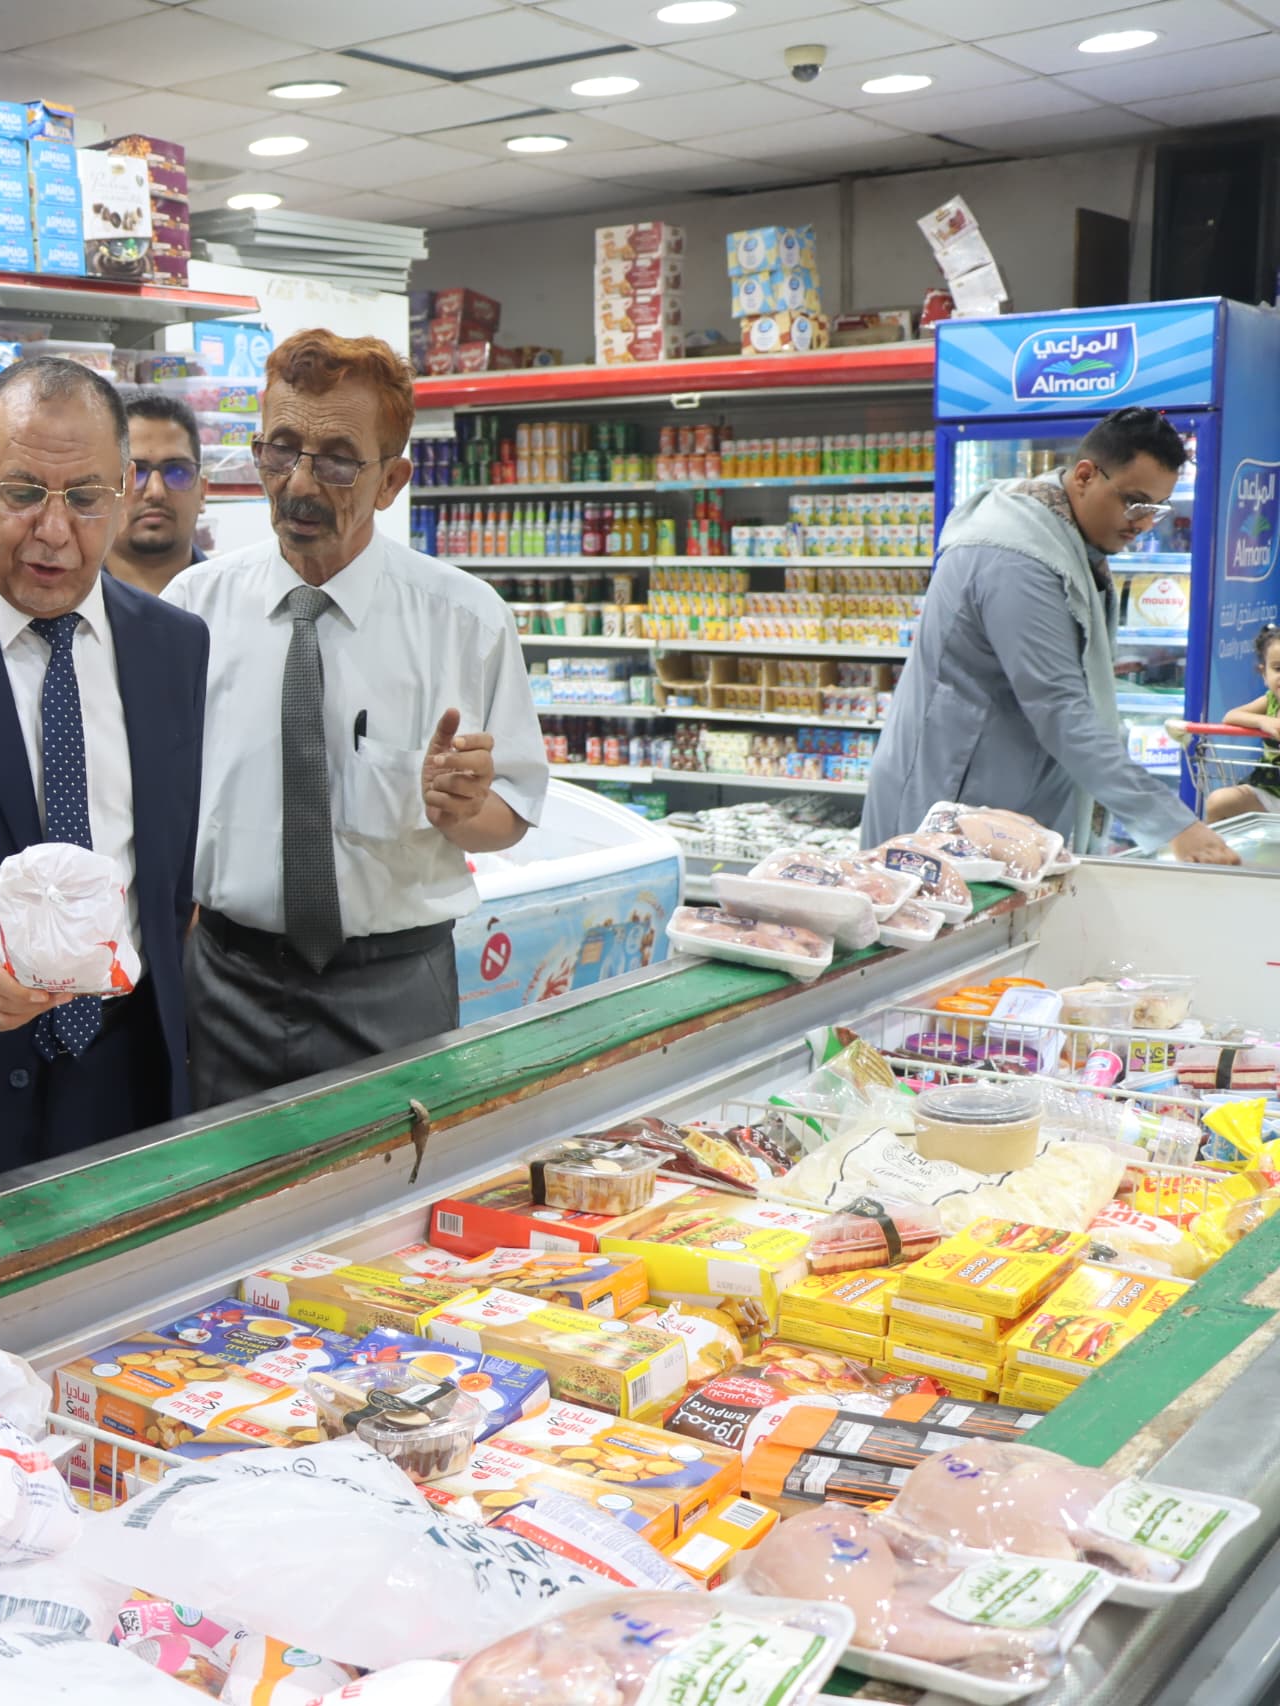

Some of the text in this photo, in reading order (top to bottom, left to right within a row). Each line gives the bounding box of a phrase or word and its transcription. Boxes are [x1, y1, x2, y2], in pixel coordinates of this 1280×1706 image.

[1032, 332, 1118, 359] المراعي
[1030, 374, 1116, 394] Almarai
[1238, 473, 1276, 511] المراعي
[1233, 538, 1271, 567] Almarai
[66, 1382, 89, 1403] ساديا
[66, 1400, 89, 1421] Sadia
[557, 1407, 598, 1425] ساديا
[691, 1401, 751, 1423] Tempura
[547, 1416, 585, 1434] Sadia
[472, 1460, 512, 1478] Sadia
[483, 1451, 525, 1469] ساديا
